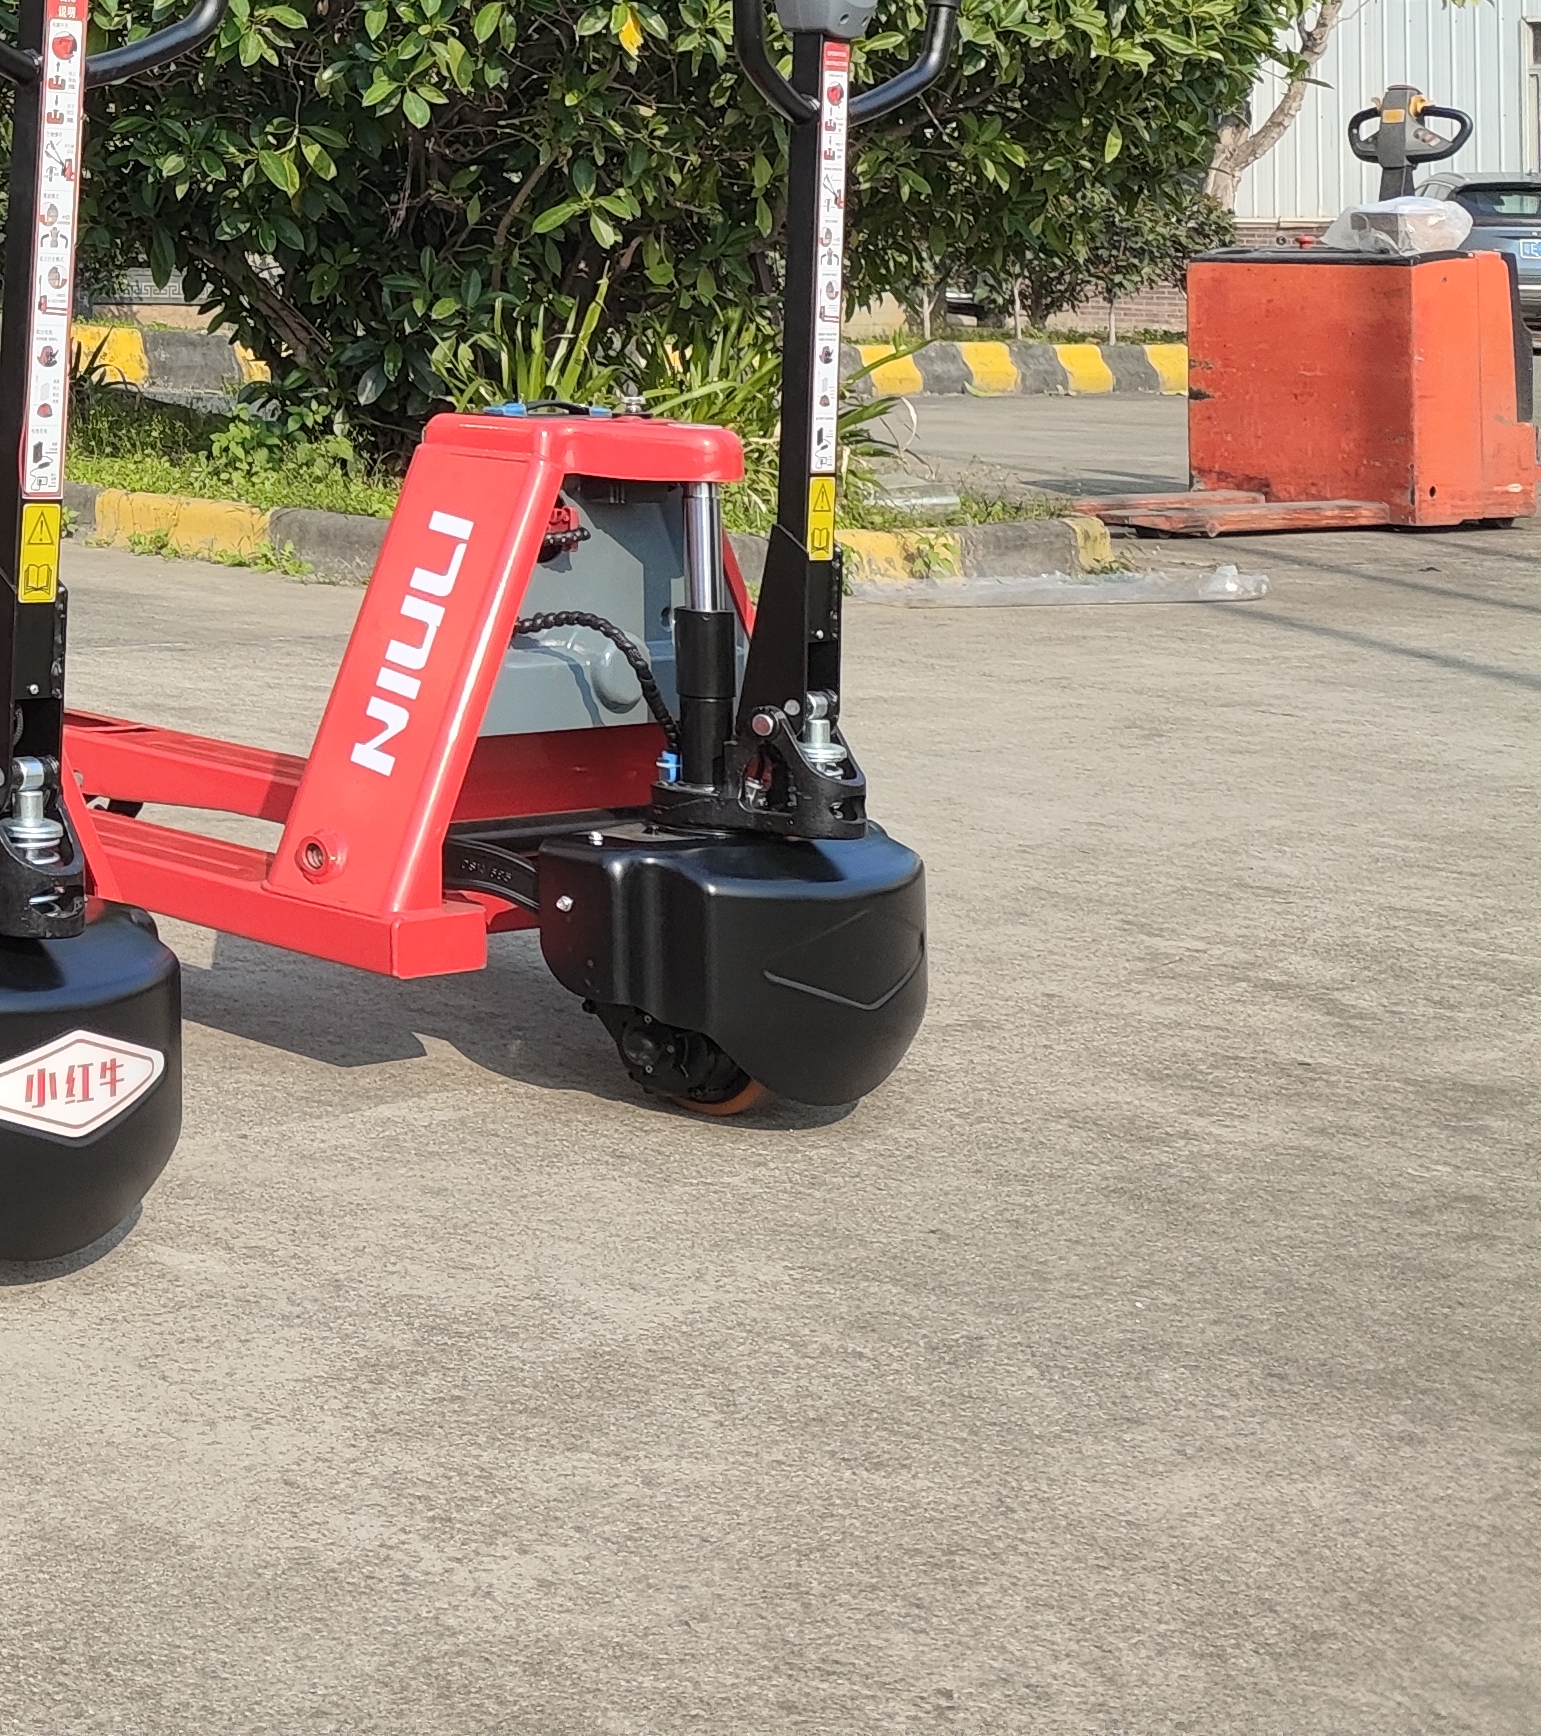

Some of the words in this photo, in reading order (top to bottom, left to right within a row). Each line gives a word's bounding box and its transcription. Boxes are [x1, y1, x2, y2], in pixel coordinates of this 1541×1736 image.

[58, 5, 77, 20] 说明
[350, 510, 474, 777] NIULI
[24, 1057, 126, 1109] 小红牛
